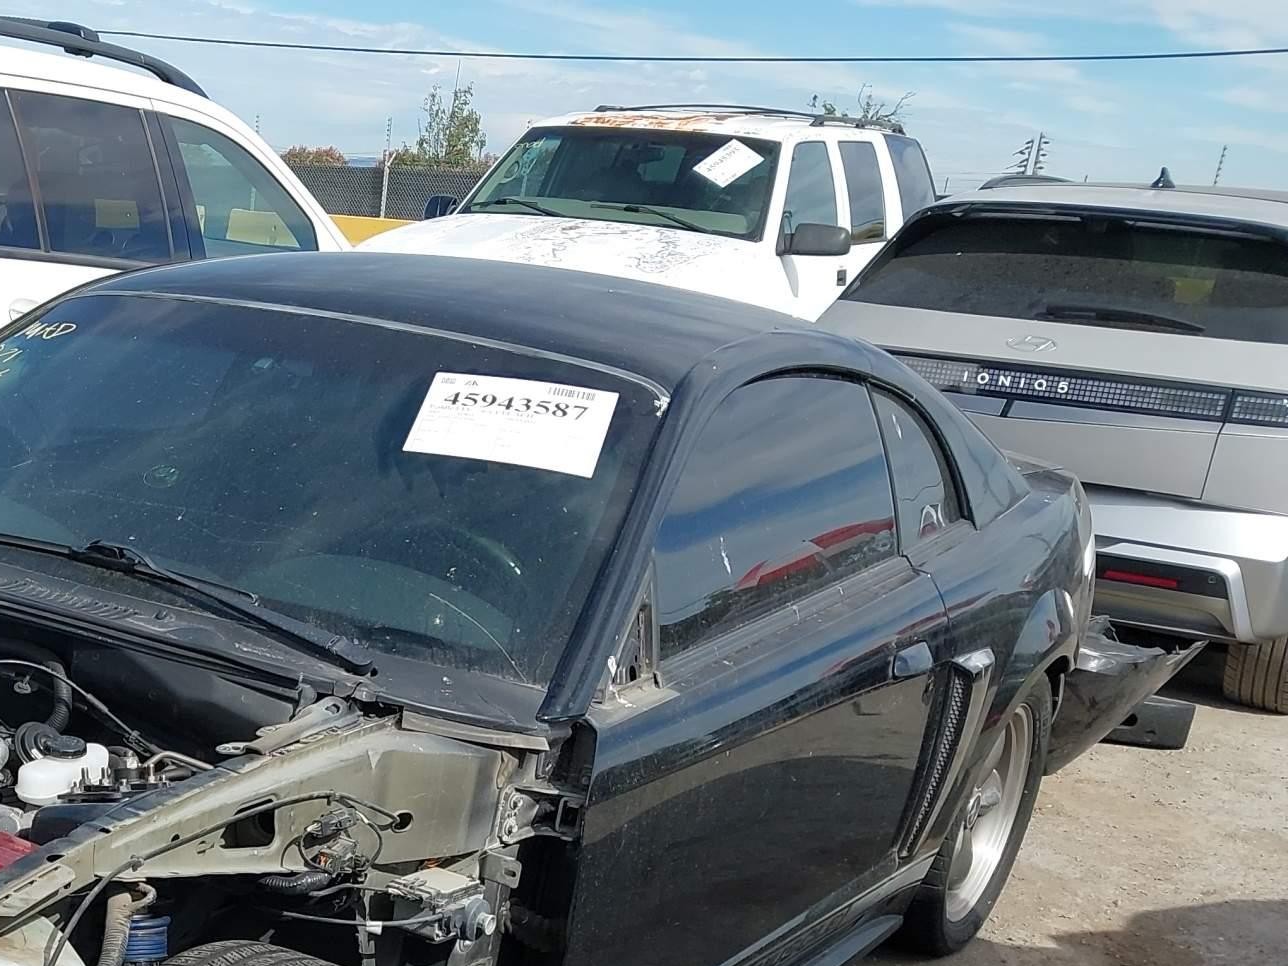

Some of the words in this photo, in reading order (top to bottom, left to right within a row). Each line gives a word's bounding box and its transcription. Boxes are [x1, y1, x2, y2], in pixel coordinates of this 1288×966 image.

[962, 370, 1047, 391] IONIQ
[1057, 381, 1069, 394] 5
[443, 391, 589, 420] 45943587
